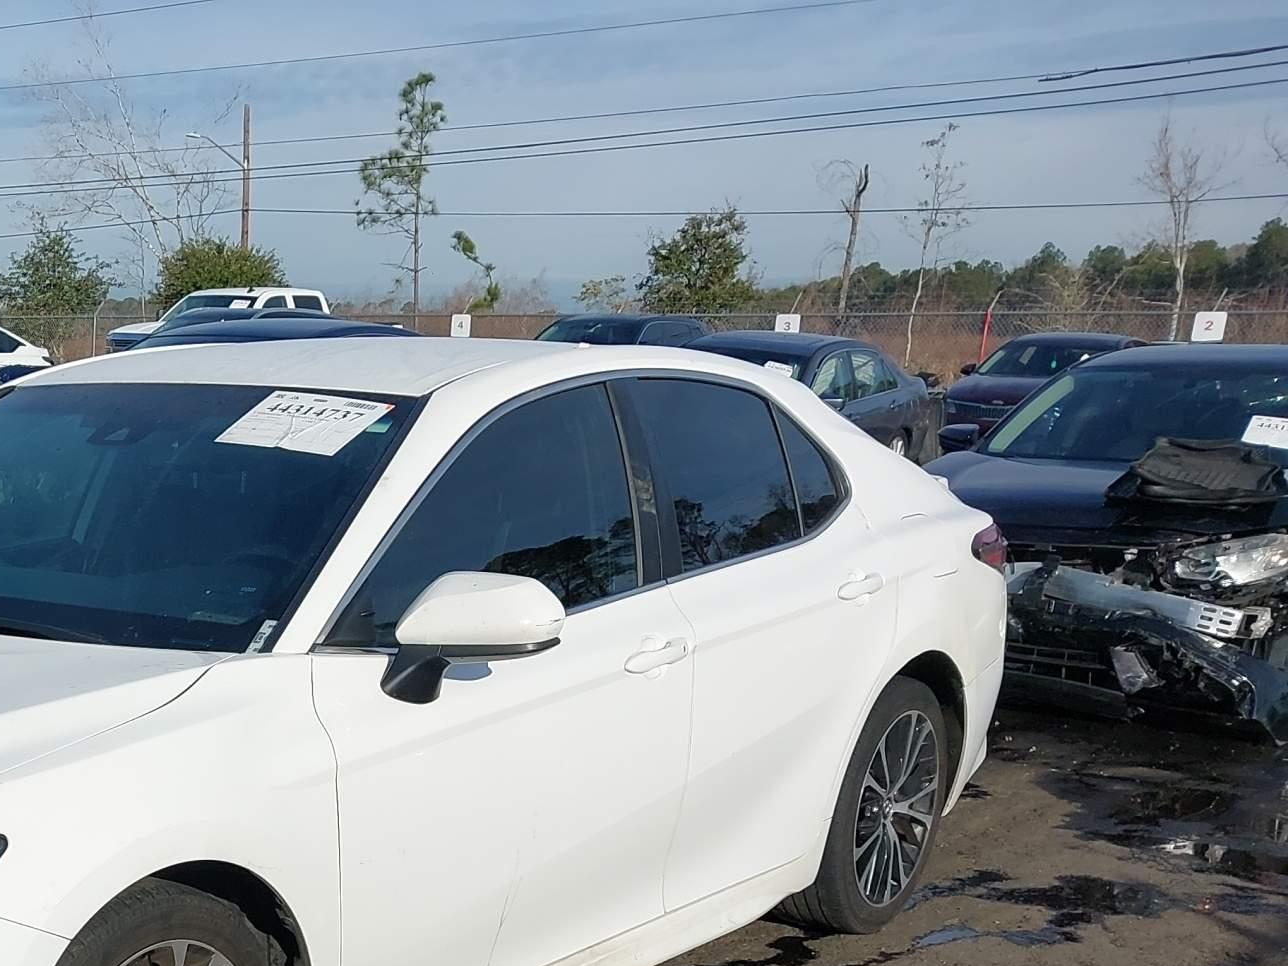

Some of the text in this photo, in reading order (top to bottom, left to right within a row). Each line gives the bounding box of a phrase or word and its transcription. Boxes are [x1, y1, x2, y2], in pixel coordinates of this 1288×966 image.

[783, 321, 792, 331] 3
[1204, 319, 1214, 331] 2
[266, 402, 367, 422] 44314737
[1256, 422, 1288, 432] 4431
